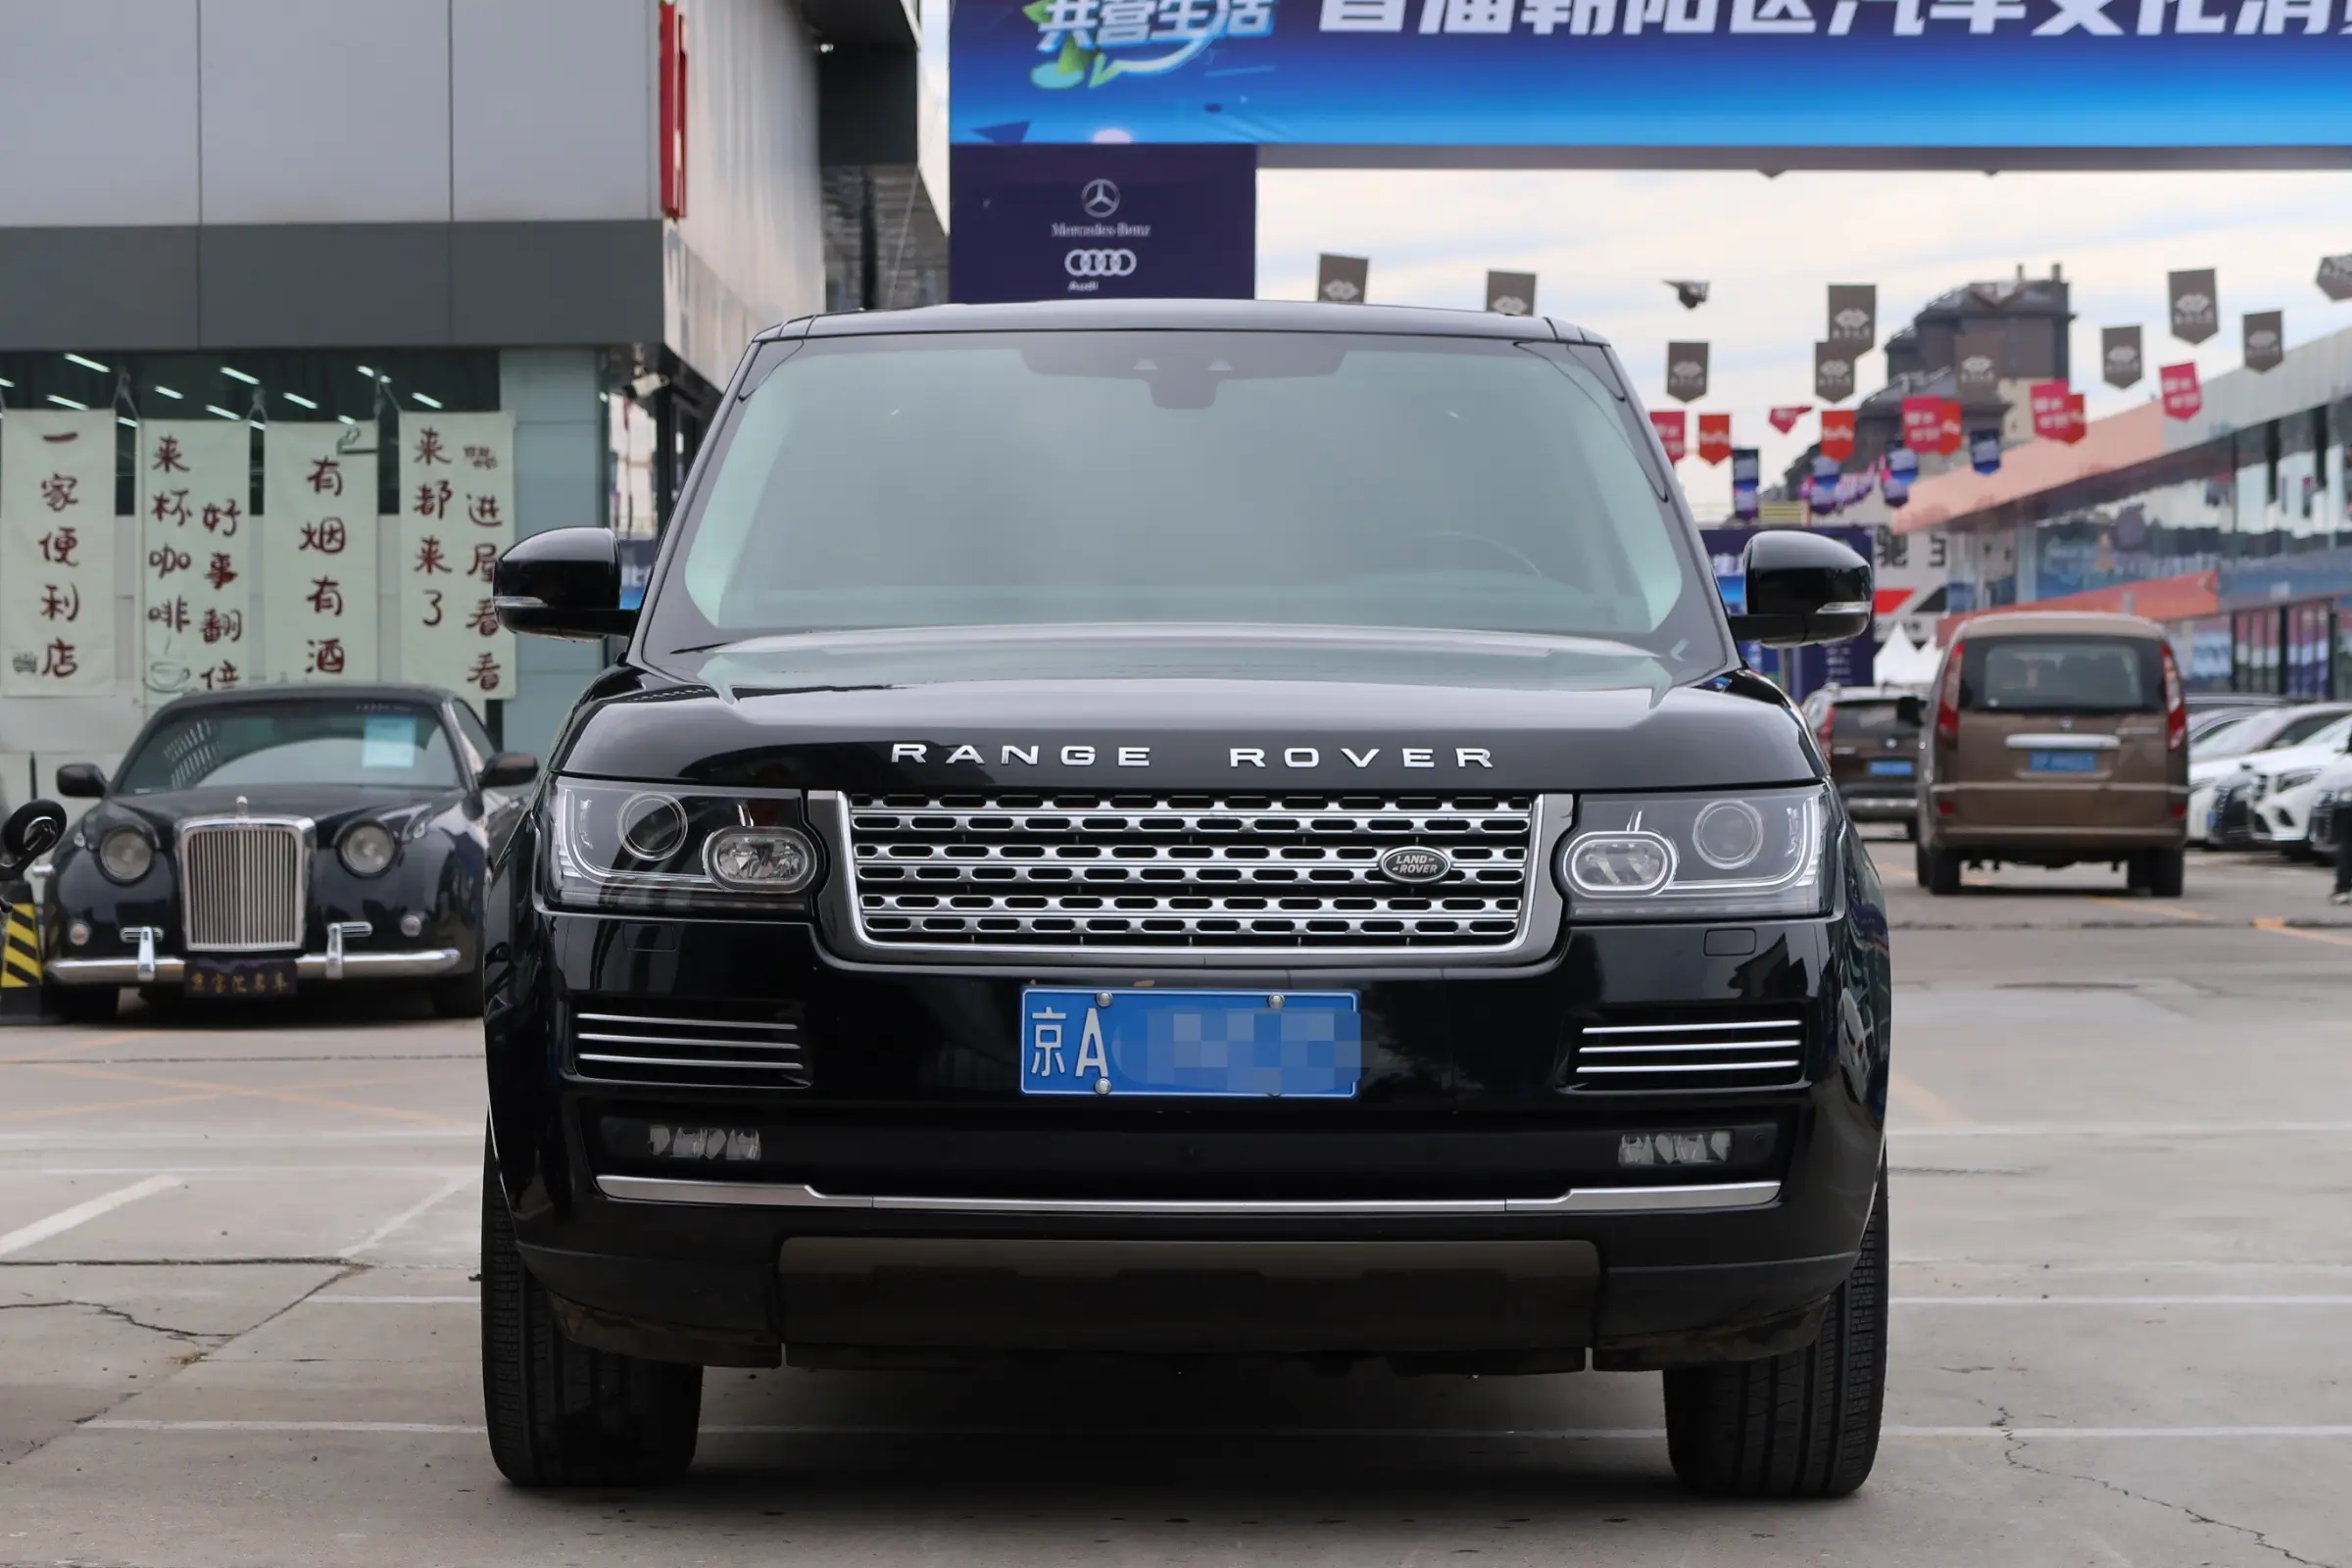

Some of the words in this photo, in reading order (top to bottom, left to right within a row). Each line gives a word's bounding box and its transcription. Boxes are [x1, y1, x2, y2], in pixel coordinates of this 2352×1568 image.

[1067, 280, 1100, 292] Audi
[39, 430, 80, 678] 一家便利店
[147, 434, 191, 633] 来杯咖啡
[198, 498, 242, 689] 好事翻倍
[298, 455, 347, 675] 有烟有酒
[413, 425, 453, 627] 来都来了
[890, 742, 1152, 768] RANGE
[1229, 746, 1494, 769] ROVER
[1396, 855, 1428, 864] LAND
[1398, 863, 1438, 874] ROVER
